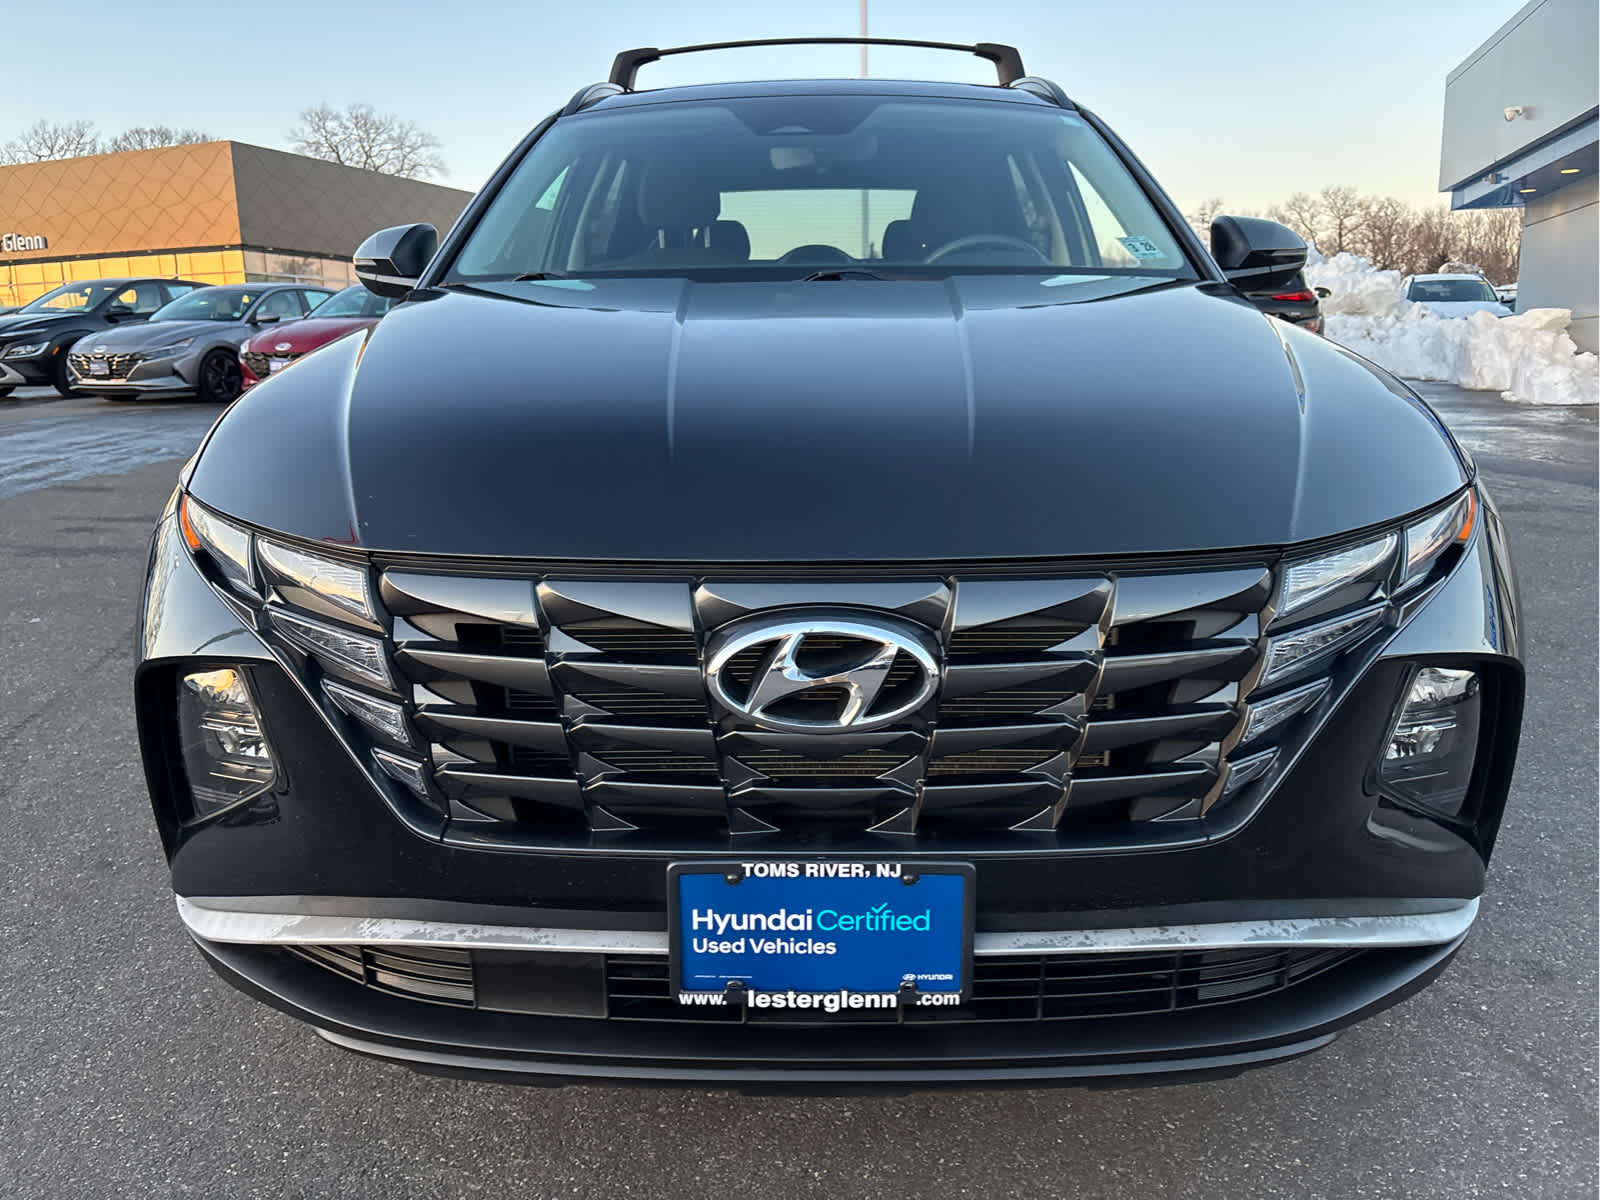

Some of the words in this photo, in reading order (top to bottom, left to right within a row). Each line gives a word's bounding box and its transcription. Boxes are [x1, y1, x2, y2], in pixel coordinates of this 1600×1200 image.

[3, 233, 44, 251] Glenn
[742, 863, 800, 878] TOMS
[805, 863, 871, 879] RIVER,
[876, 864, 902, 878] NJ
[692, 909, 813, 935] Hyundai
[816, 902, 931, 932] Certified
[692, 938, 746, 954] Used
[749, 938, 837, 955] Vehicles
[679, 993, 727, 1005] www.
[748, 990, 897, 1012] lesterglenn
[916, 992, 960, 1006] .com
